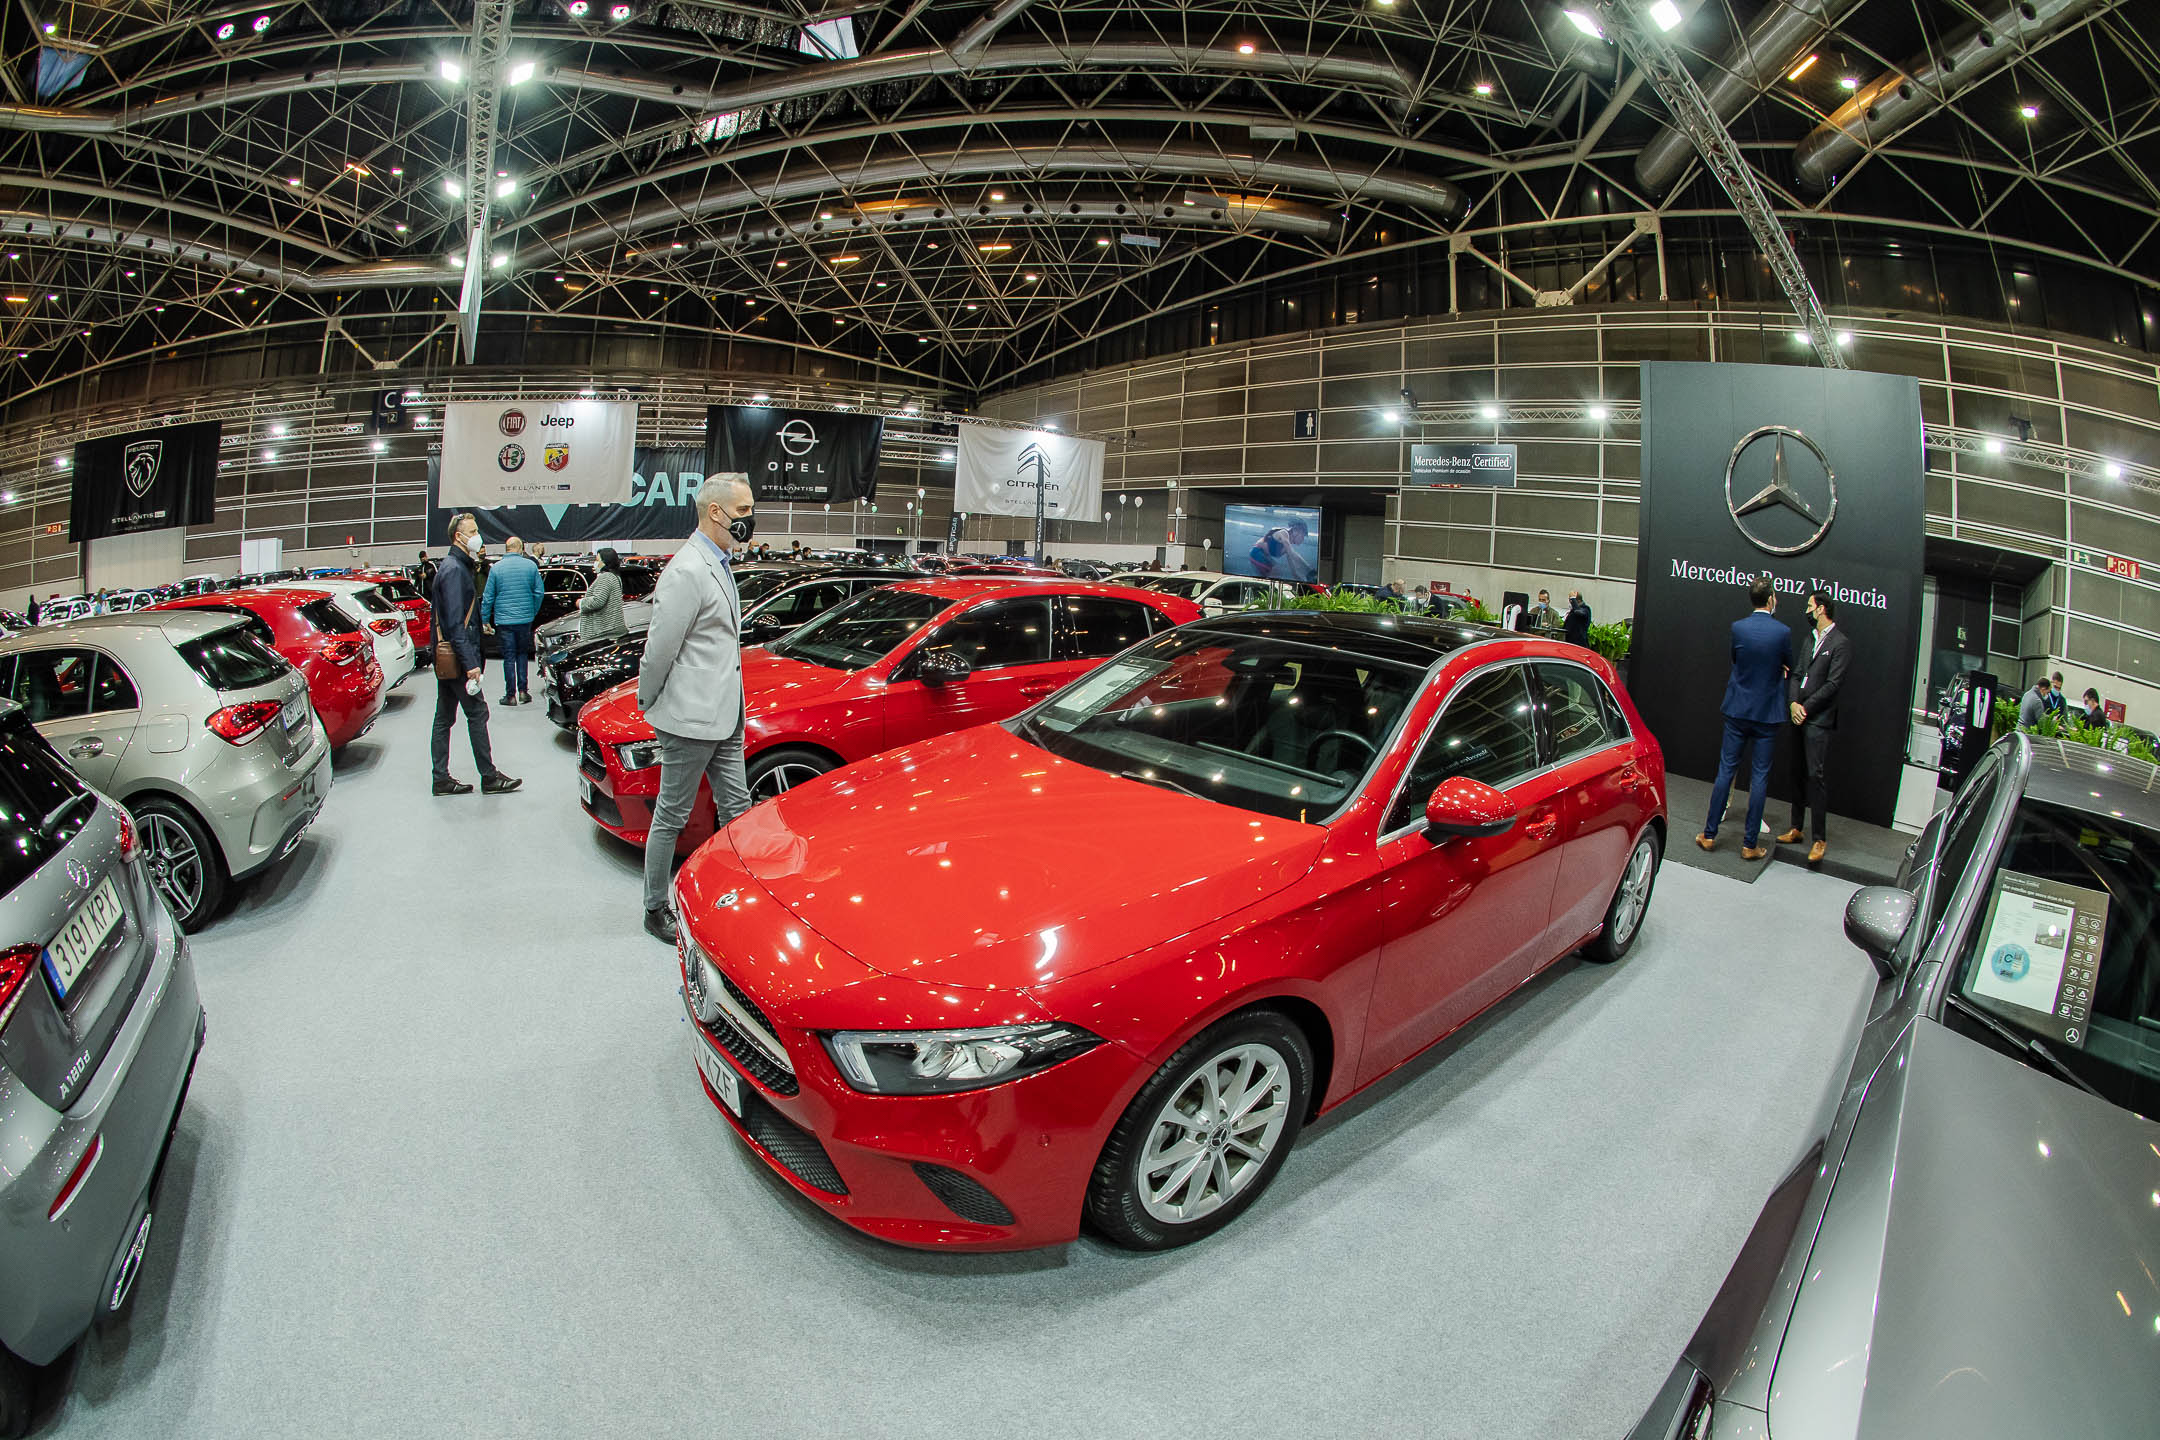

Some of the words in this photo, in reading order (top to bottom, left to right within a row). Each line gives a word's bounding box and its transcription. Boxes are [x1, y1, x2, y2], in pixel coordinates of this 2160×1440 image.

[384, 391, 397, 409] C
[506, 416, 522, 429] FIAT
[540, 414, 575, 429] Jeep
[128, 444, 160, 453] PEUGEOT
[767, 461, 825, 473] OPEL
[1413, 455, 1471, 467] Mercedes-Benz
[1474, 456, 1510, 468] Certified
[499, 484, 556, 493] STELLANTIS
[761, 483, 814, 493] STELLANTIS
[111, 511, 154, 524] STELLANTIS
[55, 913, 94, 978] 3191
[86, 884, 118, 936] KPX
